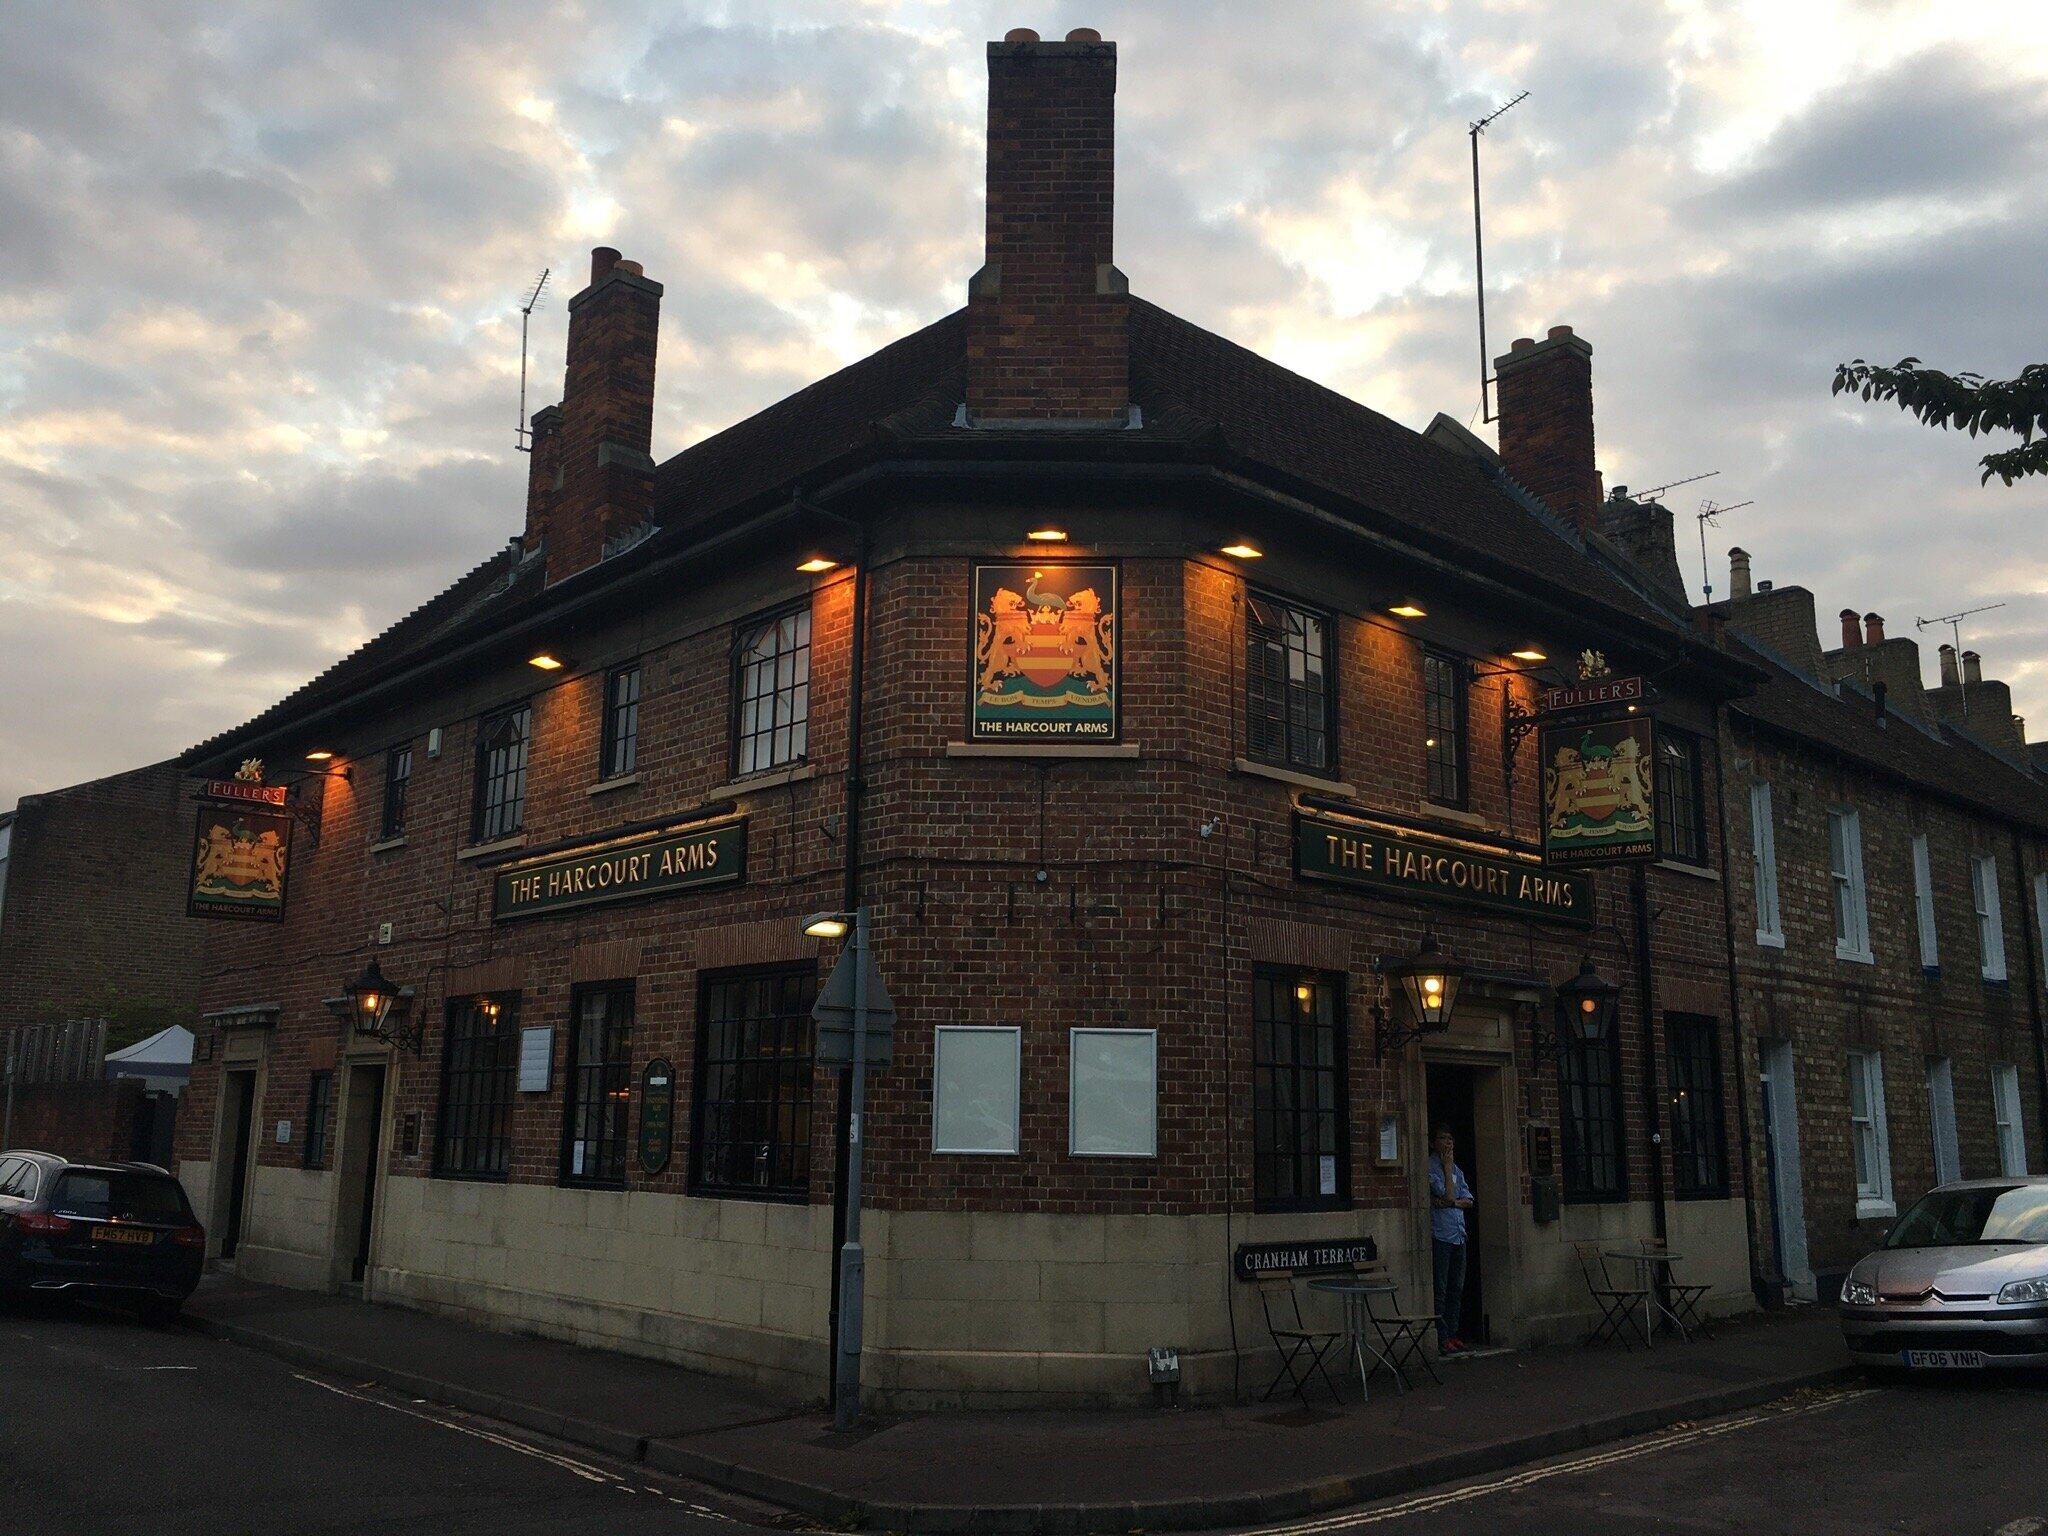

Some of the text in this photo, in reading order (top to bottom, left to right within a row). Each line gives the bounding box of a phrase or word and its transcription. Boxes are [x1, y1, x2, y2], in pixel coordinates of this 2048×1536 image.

[980, 721, 1108, 733] THE HARCOURT ARMS
[1550, 843, 1652, 860] THE HARCOURT ARMS
[511, 839, 718, 903] THE HARCOURT ARMS
[1326, 835, 1573, 908] THE HARCOURT ARMS
[194, 902, 278, 916] THE HARCOURT ARMS
[1245, 1246, 1367, 1270] CRANHAM TERRACE
[1911, 1352, 1980, 1366] GF06 VNH
